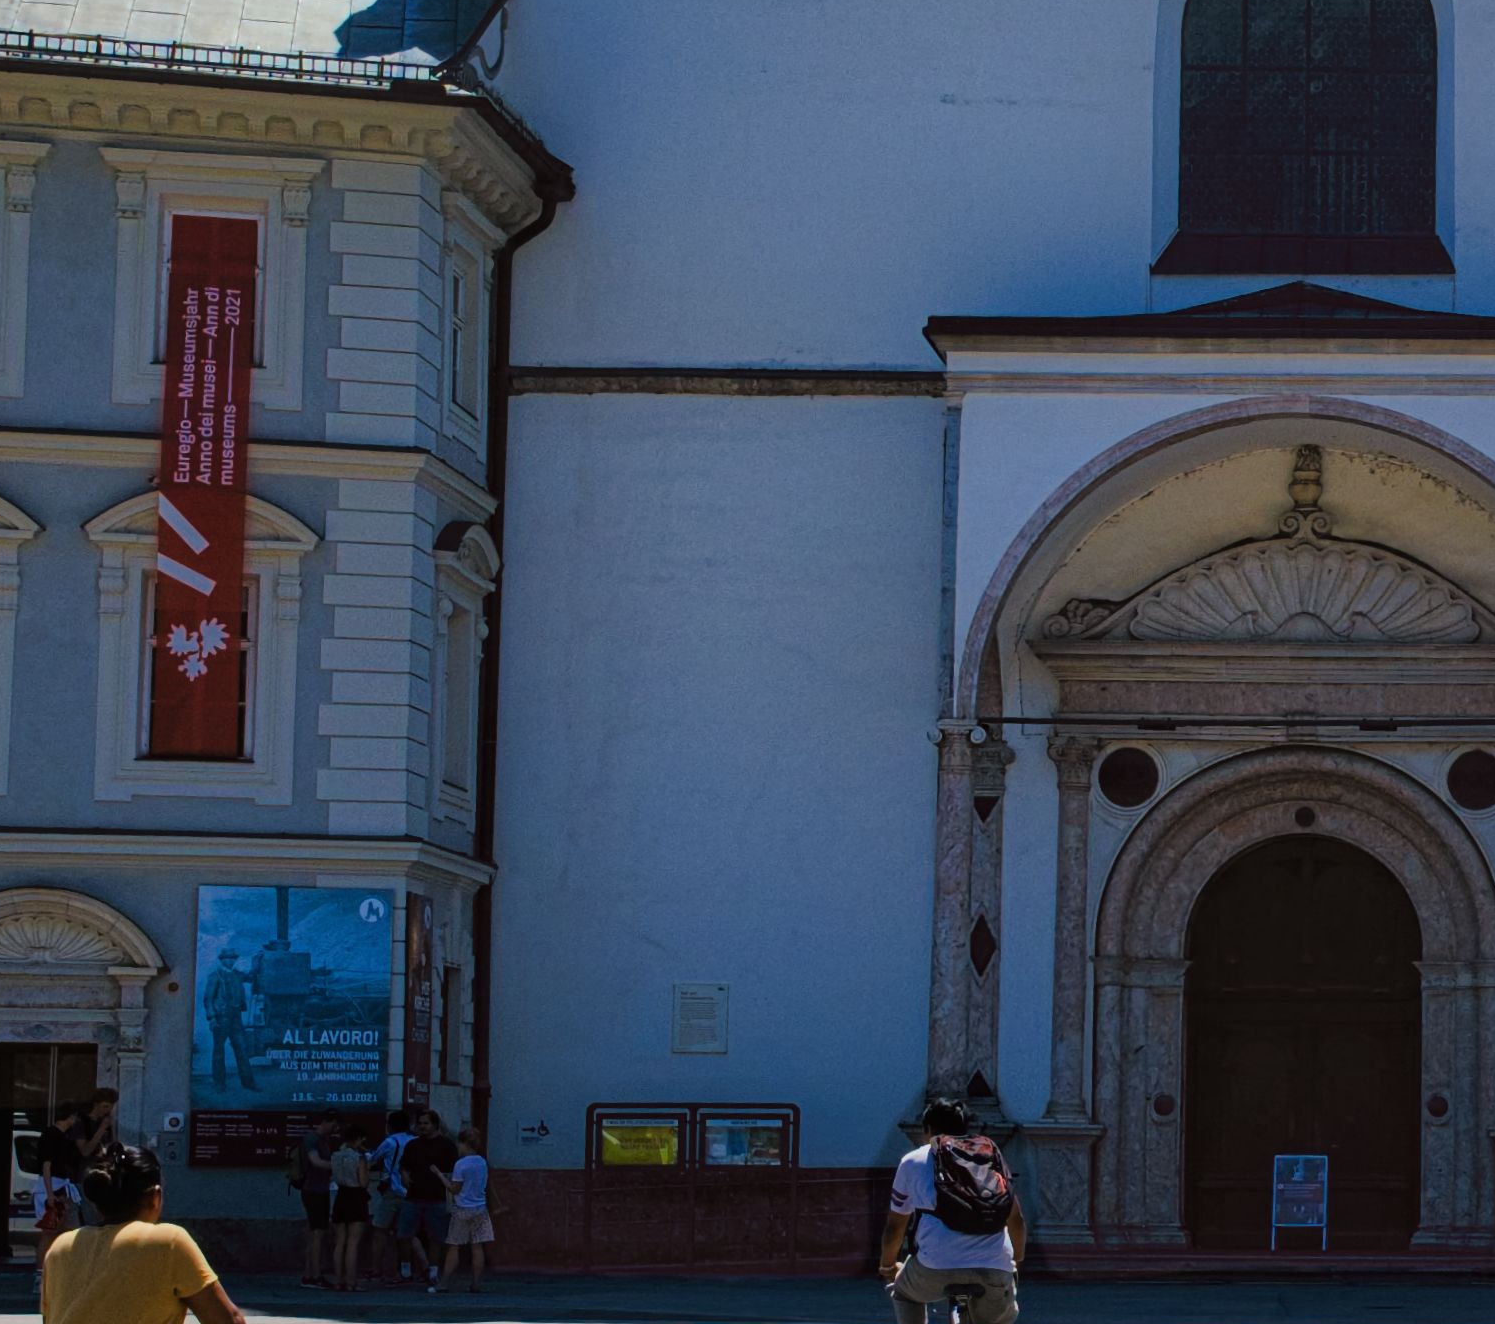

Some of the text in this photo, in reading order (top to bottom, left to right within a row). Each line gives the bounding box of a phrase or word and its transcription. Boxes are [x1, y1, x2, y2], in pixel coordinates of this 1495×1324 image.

[174, 287, 201, 483] Euregio Museumsjahr
[196, 286, 220, 485] Anno dei musei Ann di
[221, 288, 242, 485] museums 2021
[280, 1061, 299, 1070] AUS
[282, 1029, 379, 1046] AL LAVORO!
